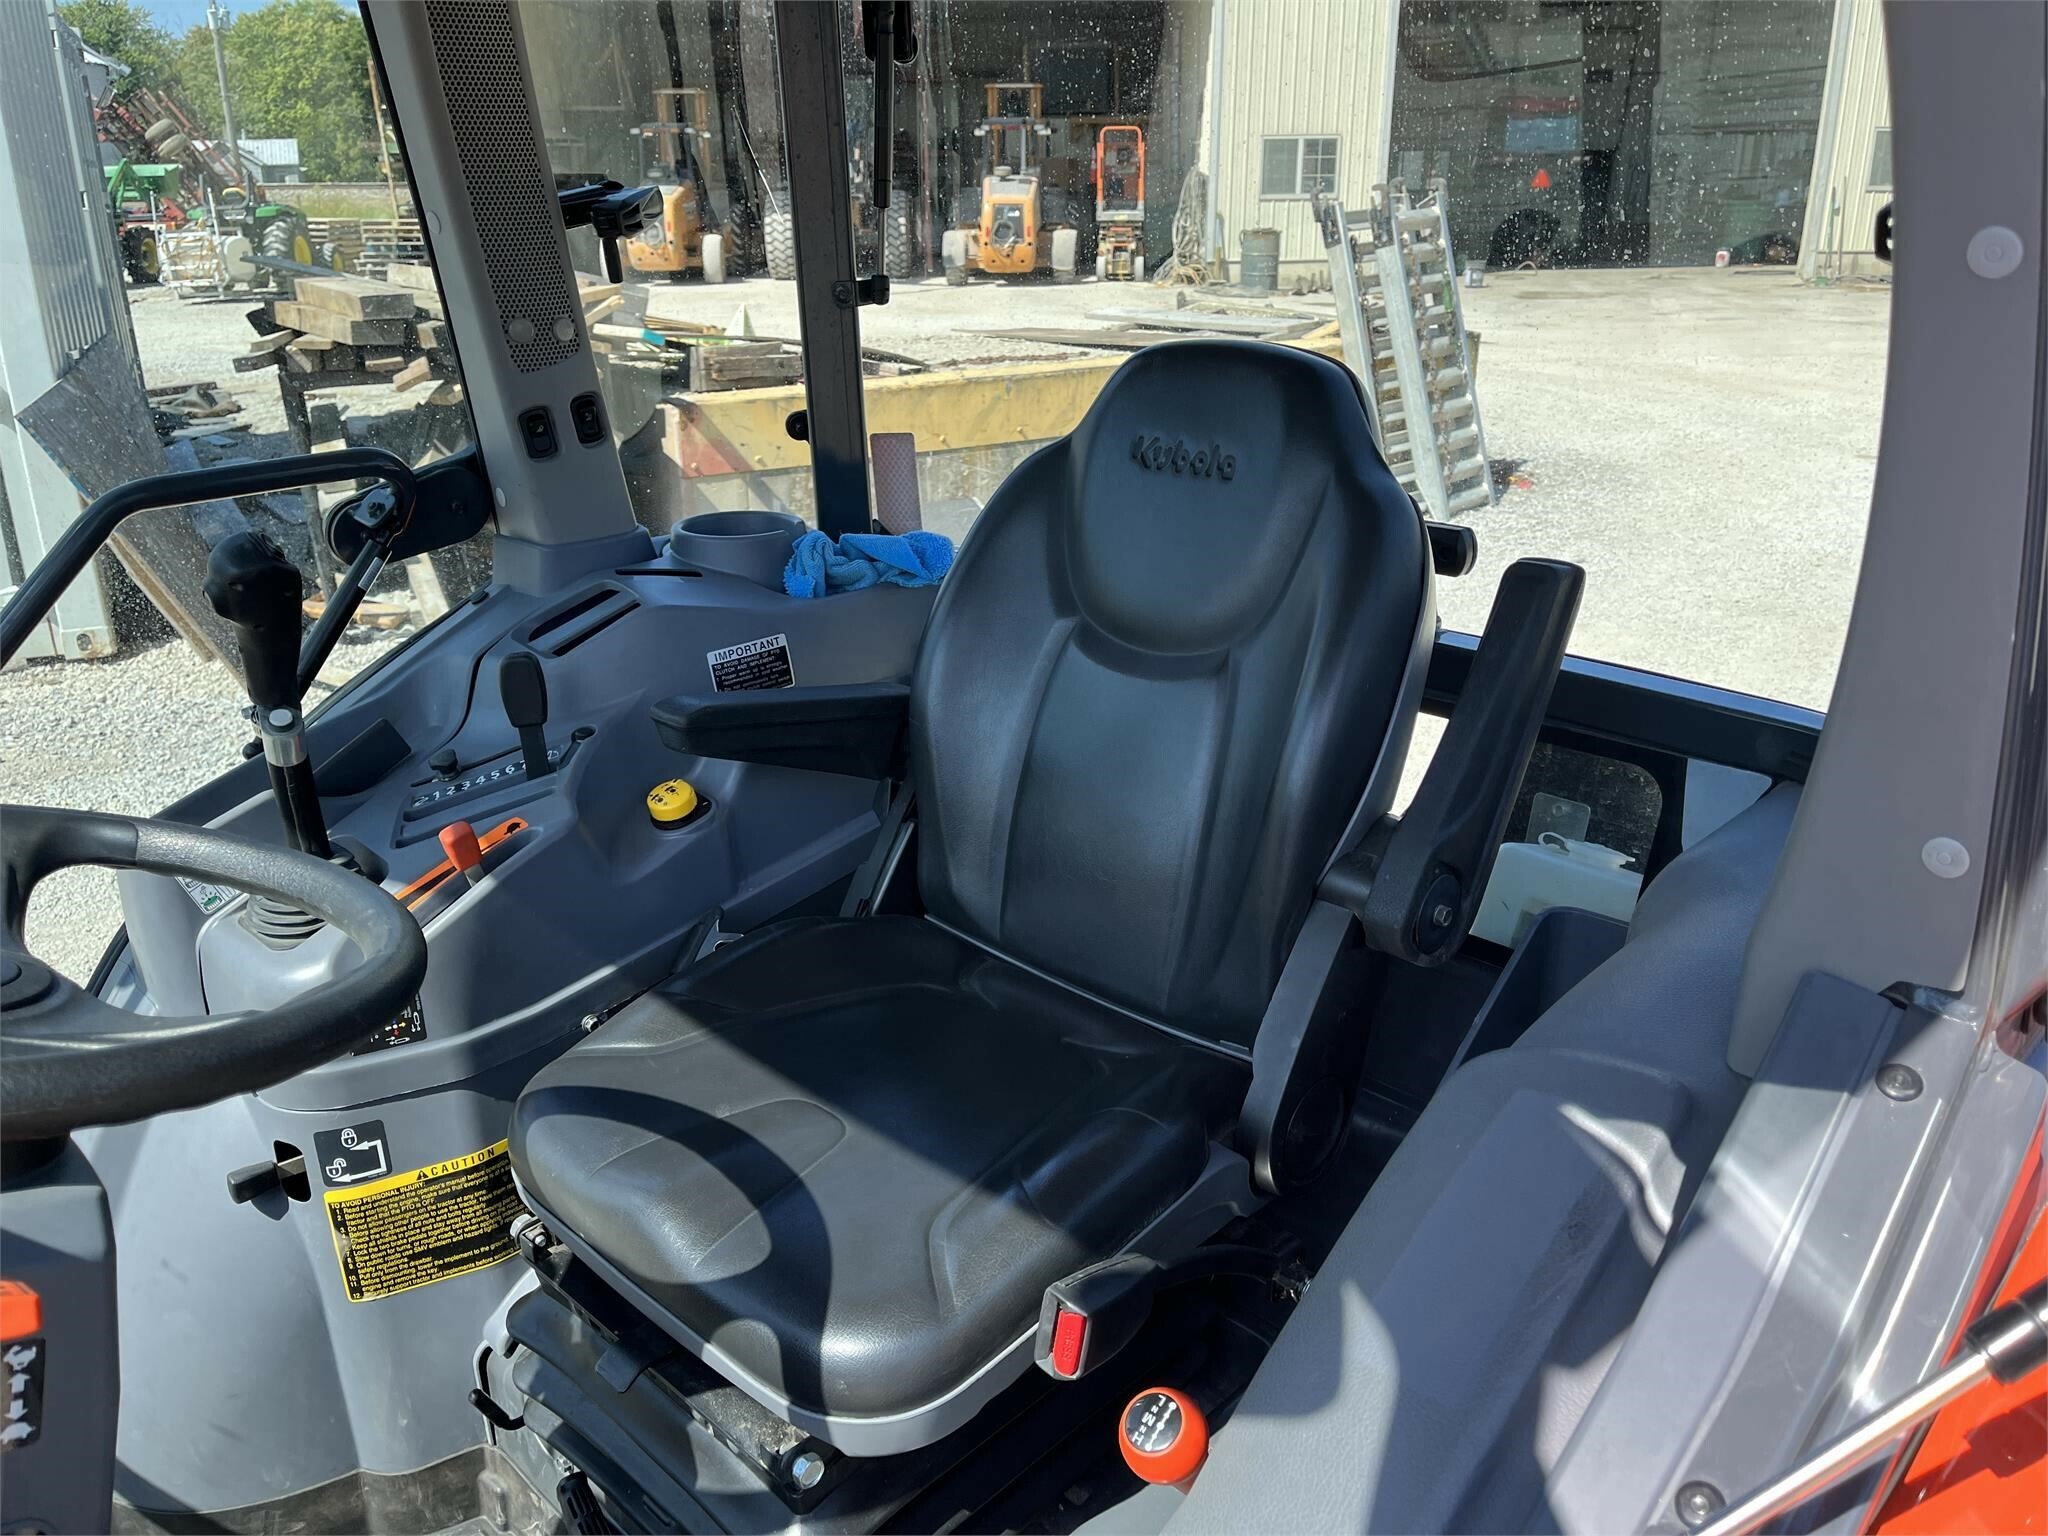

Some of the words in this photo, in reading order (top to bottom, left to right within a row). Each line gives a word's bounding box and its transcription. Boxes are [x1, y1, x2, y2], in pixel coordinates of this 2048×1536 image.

[1131, 434, 1237, 481] Kubota
[714, 637, 780, 662] IMPORTANT
[723, 660, 739, 668] AVOID
[432, 790, 440, 800] 1
[446, 786, 456, 796] 2
[461, 781, 471, 791] 3
[475, 775, 487, 785] 4
[490, 770, 500, 780] 5
[505, 764, 515, 775] 6
[431, 1148, 495, 1178] CAUTION
[340, 1198, 361, 1207] AVOID
[362, 1188, 399, 1202] PERSONAL
[343, 1205, 359, 1213] Read
[400, 1203, 414, 1211] PTO
[344, 1210, 364, 1219] Before
[347, 1224, 356, 1232] Do
[353, 1248, 368, 1256] Lock
[413, 1244, 428, 1252] SMV
[1141, 1411, 1157, 1427] M
